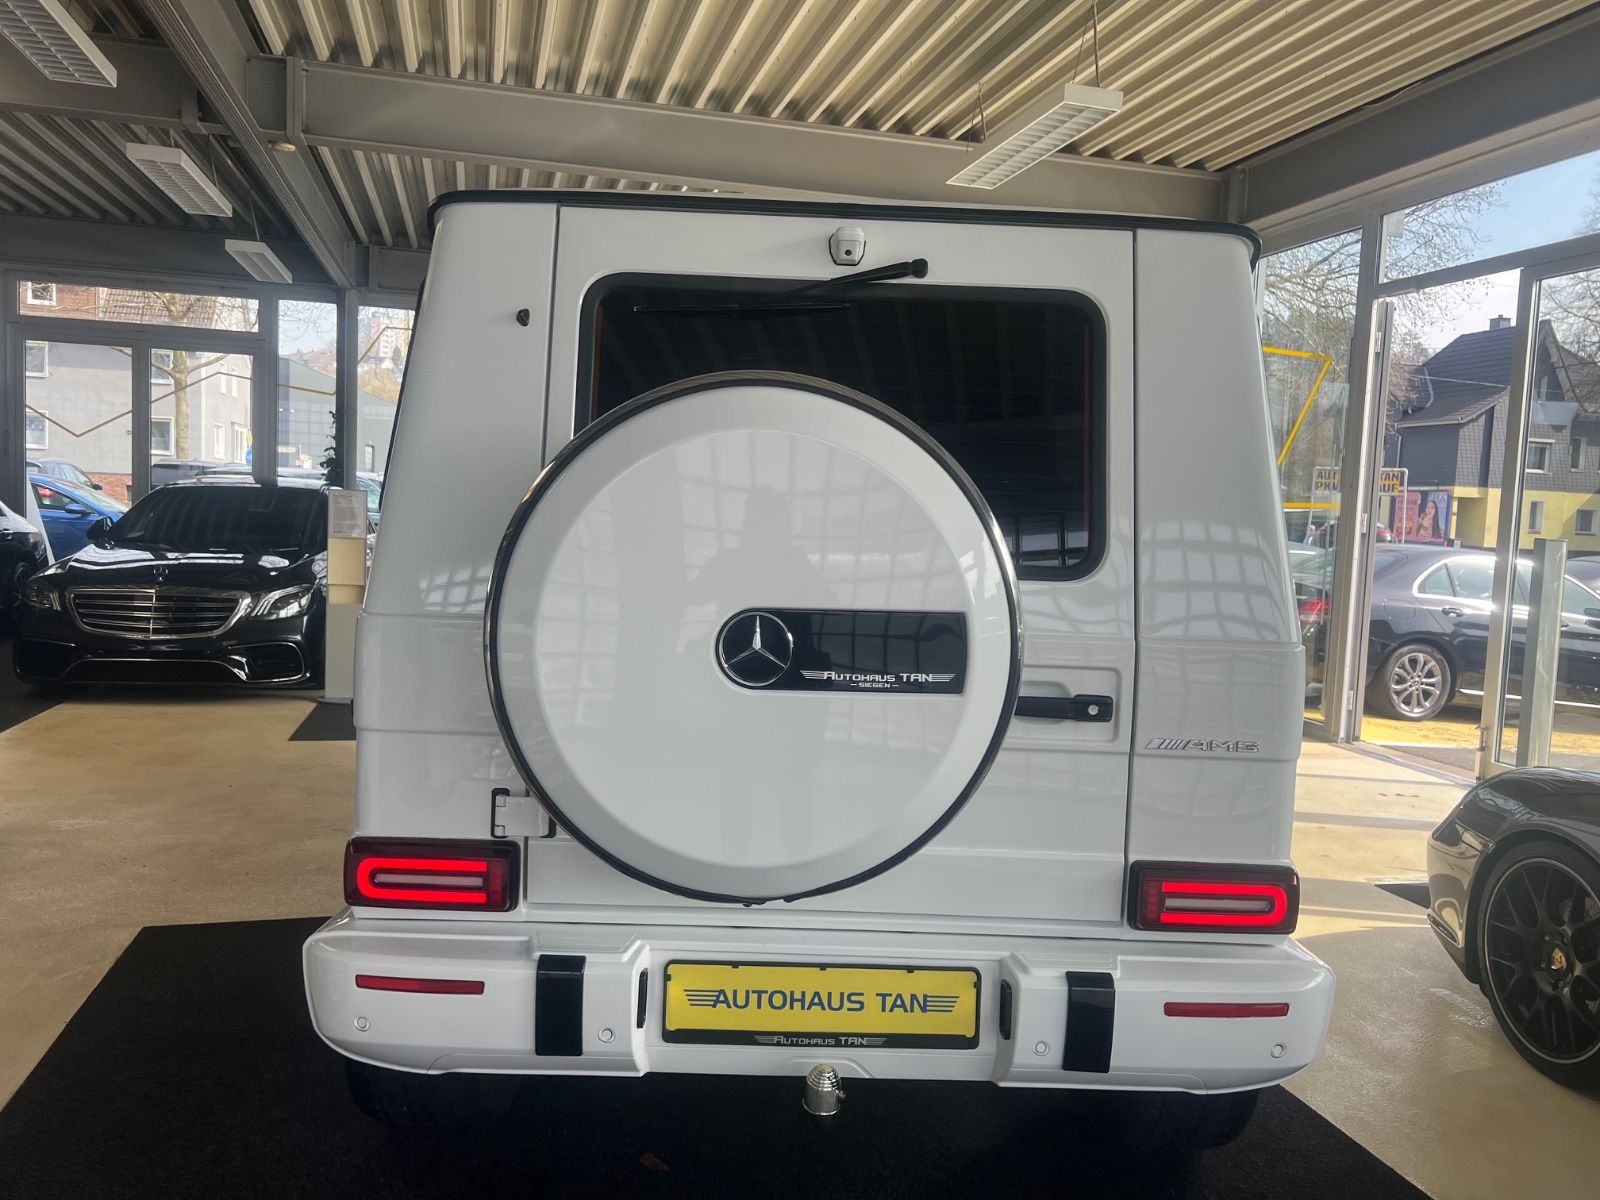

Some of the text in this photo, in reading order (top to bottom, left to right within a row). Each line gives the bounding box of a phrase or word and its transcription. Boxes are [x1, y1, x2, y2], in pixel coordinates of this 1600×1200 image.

[824, 671, 932, 682] AUTOHAUS TAN
[1182, 738, 1260, 753] AMG
[711, 988, 928, 1013] AUTOHAUS TAN
[774, 1035, 867, 1045] AUTOHAUS TAN
